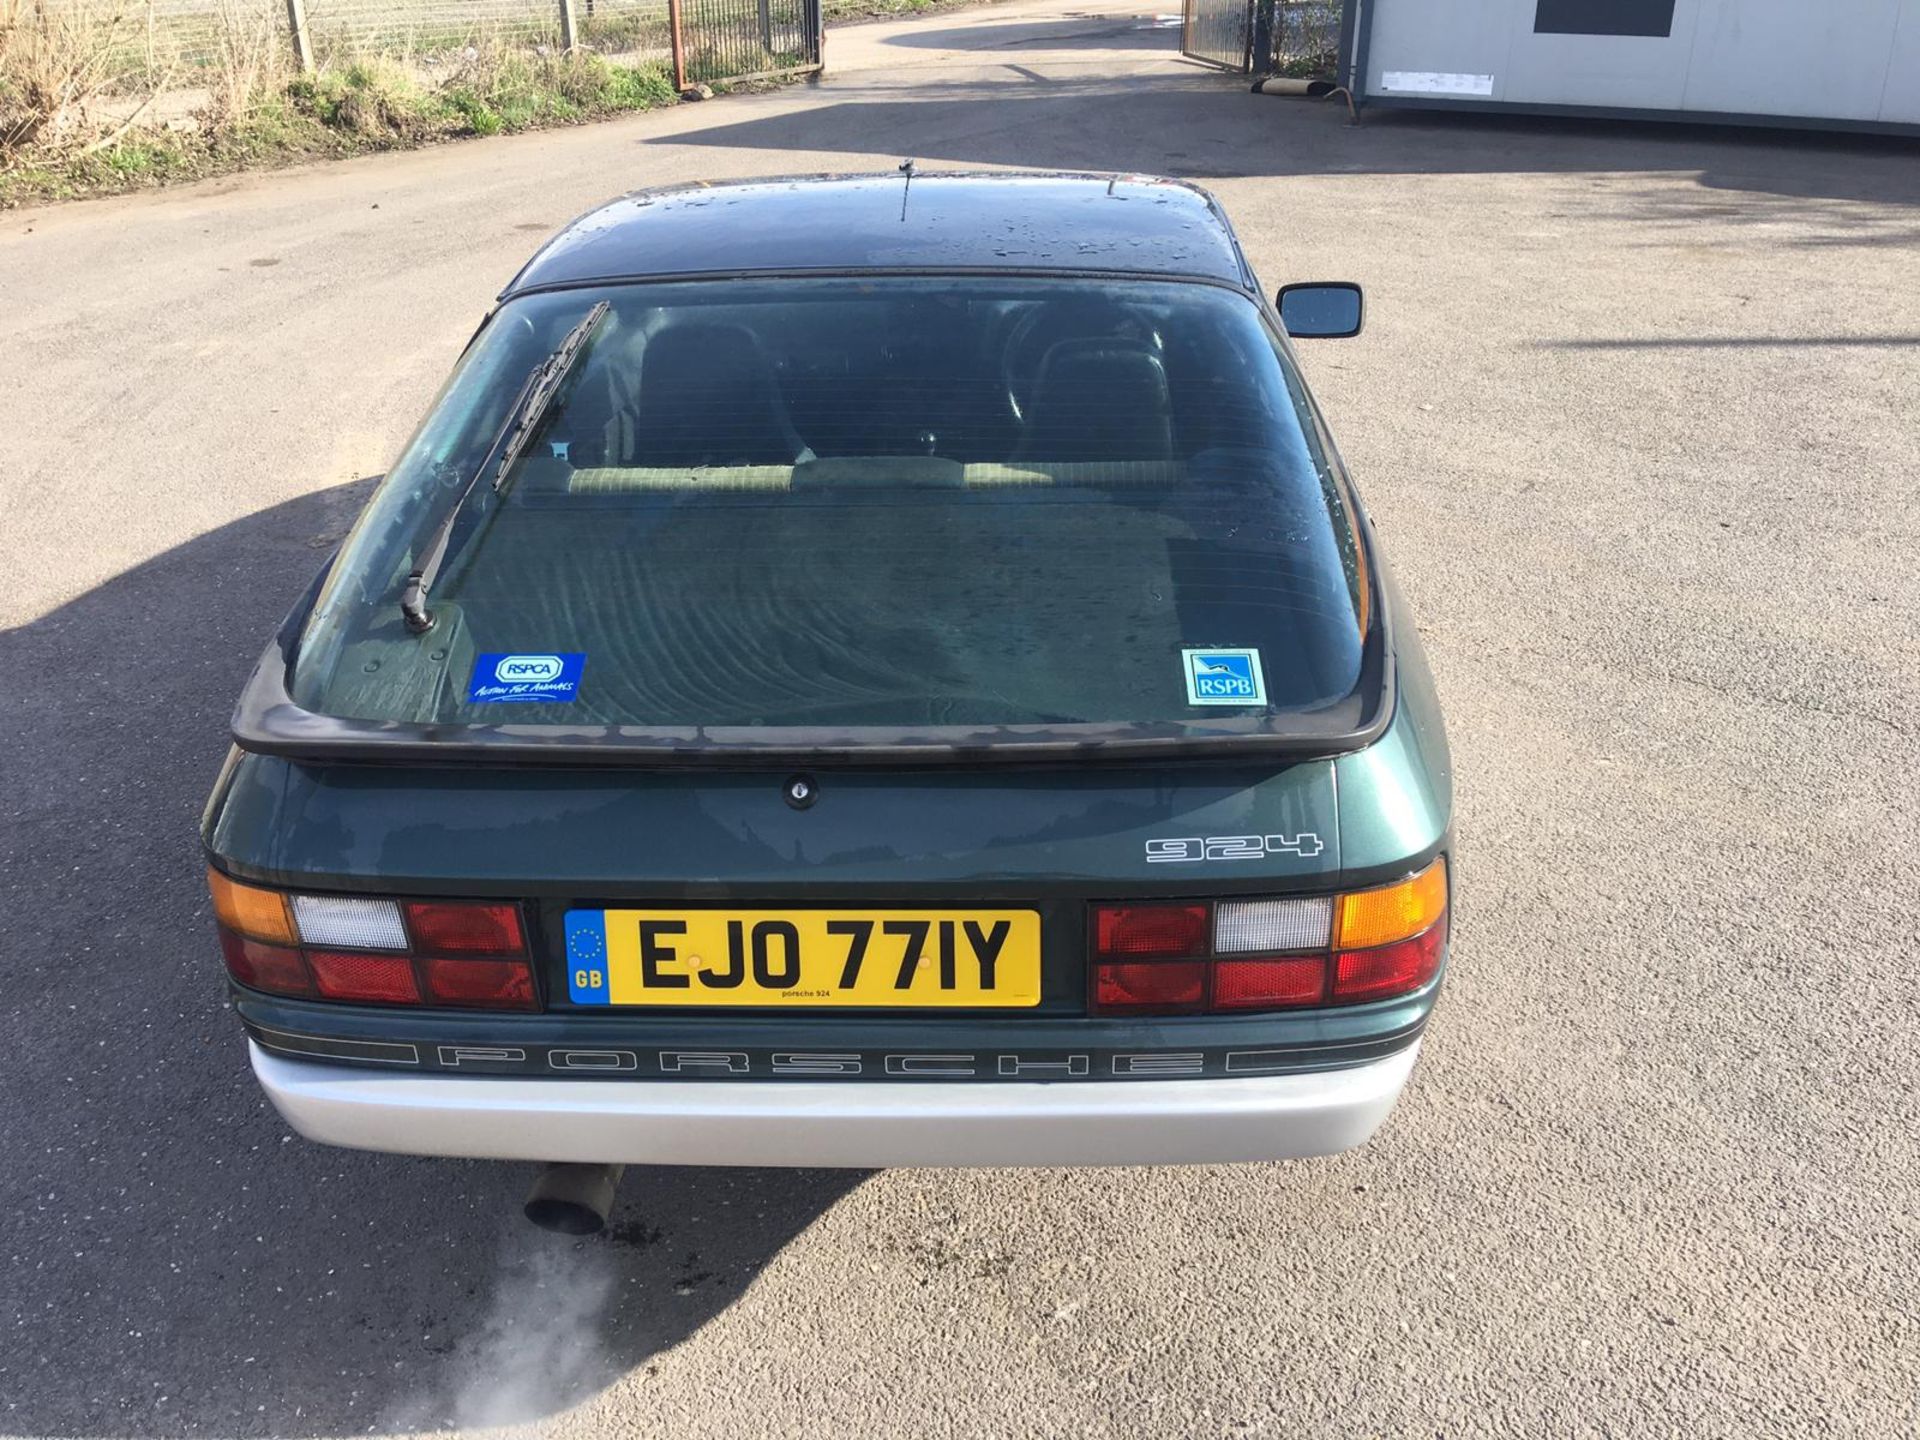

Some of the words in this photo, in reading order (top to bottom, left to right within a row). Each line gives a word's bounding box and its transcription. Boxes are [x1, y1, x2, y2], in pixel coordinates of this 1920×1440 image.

[507, 663, 551, 674] RSPCA
[509, 684, 529, 694] FOR
[529, 682, 573, 692] ANIMALS
[1199, 679, 1251, 695] RSPB
[1145, 833, 1323, 863] 924
[639, 920, 801, 988] EJO
[575, 970, 602, 988] GB
[782, 990, 814, 998] porsche
[437, 1045, 1204, 1075] PORSCHE
